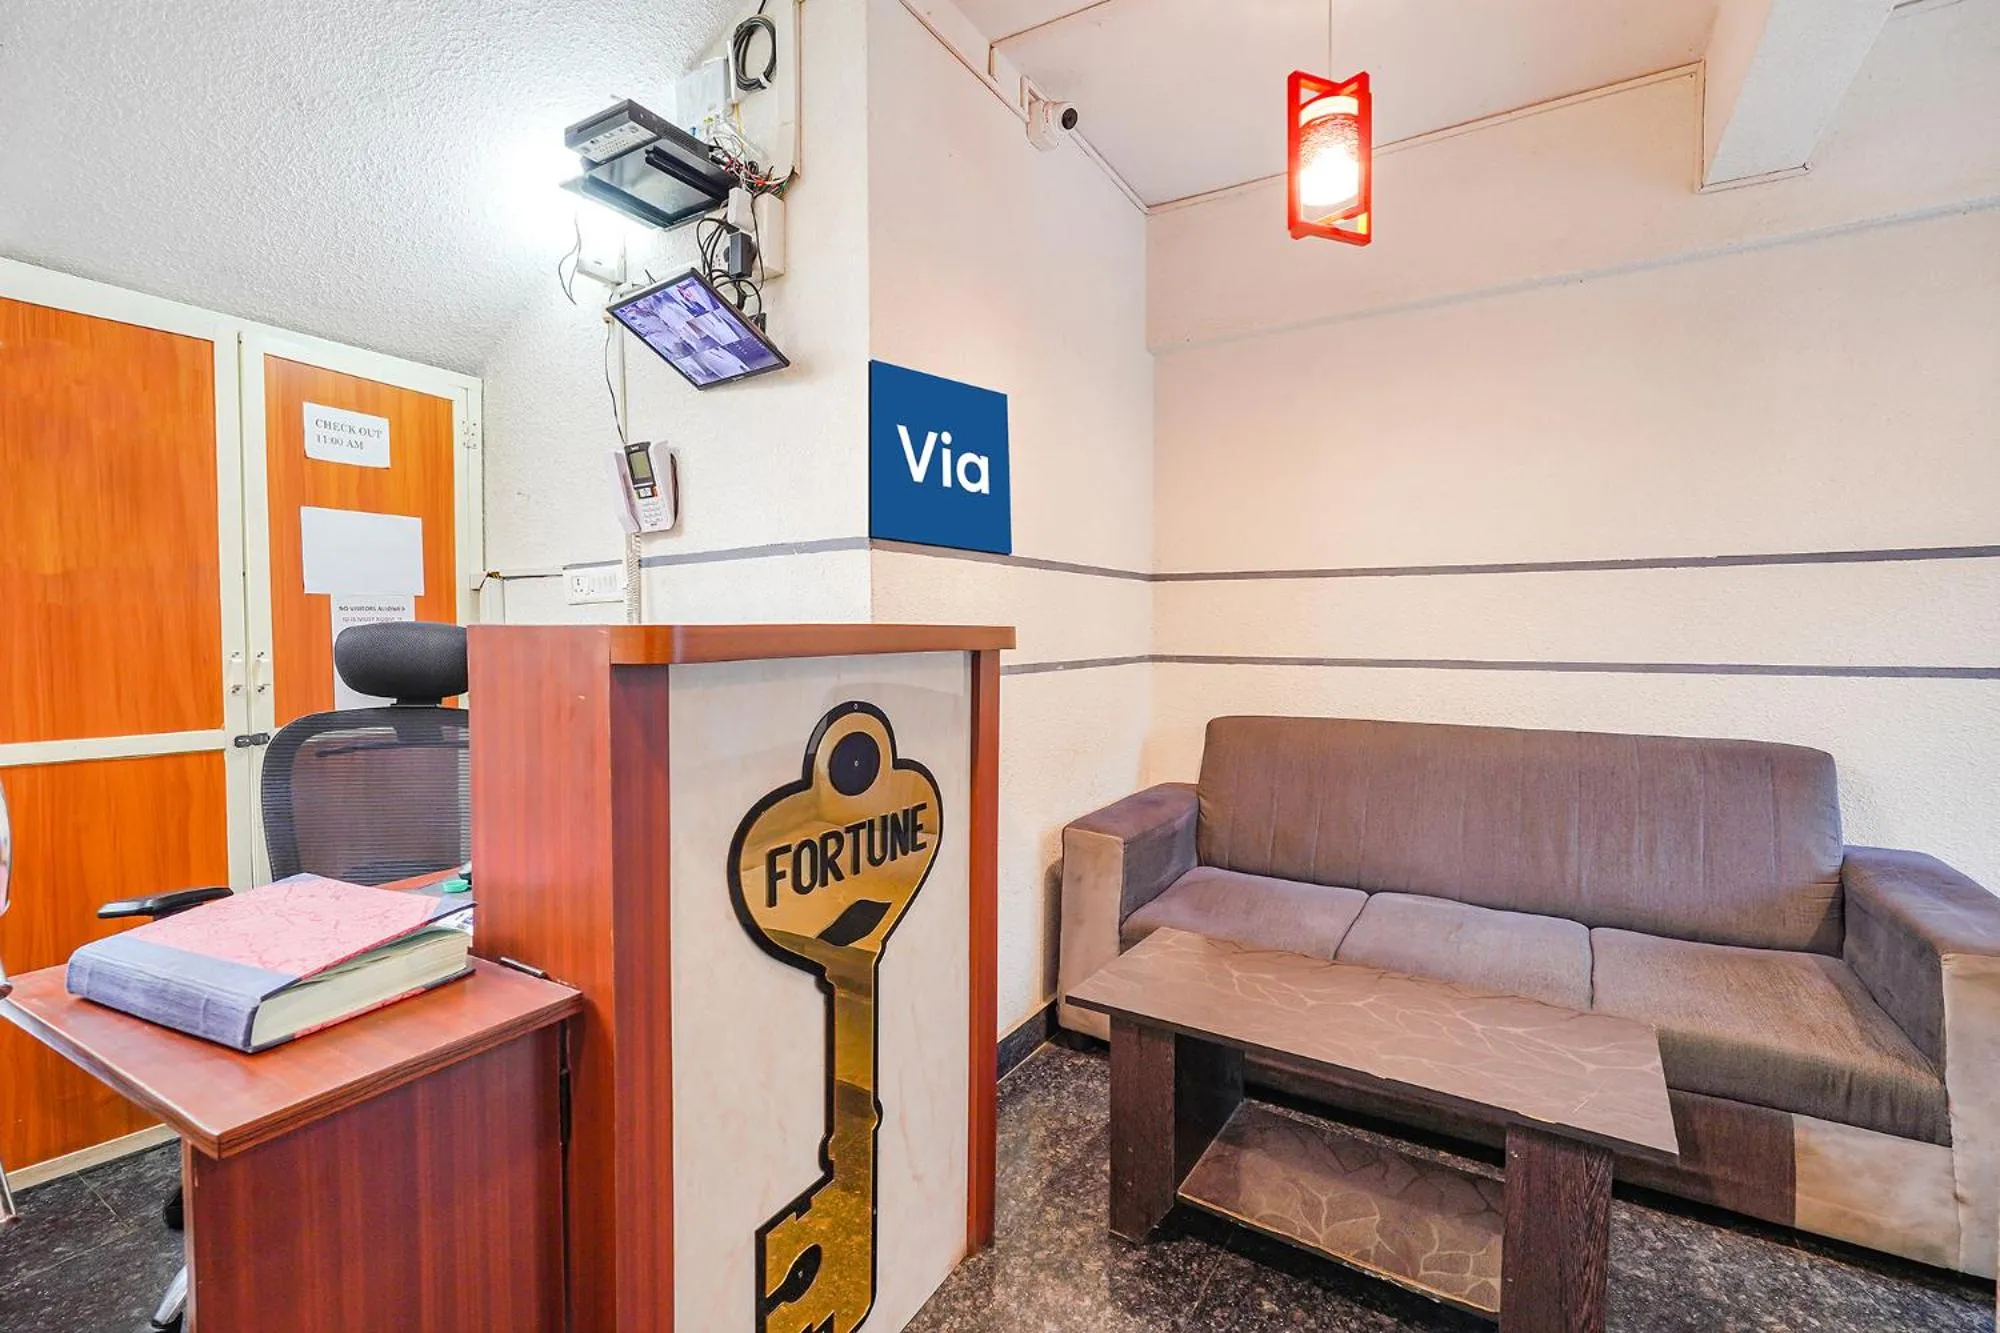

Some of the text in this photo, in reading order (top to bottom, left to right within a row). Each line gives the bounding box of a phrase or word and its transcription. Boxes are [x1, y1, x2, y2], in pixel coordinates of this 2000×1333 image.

[315, 418, 382, 439] CHECK OUT
[316, 435, 364, 450] 11:00 AM
[896, 424, 990, 495] Via
[766, 802, 928, 908] FORTUNE
